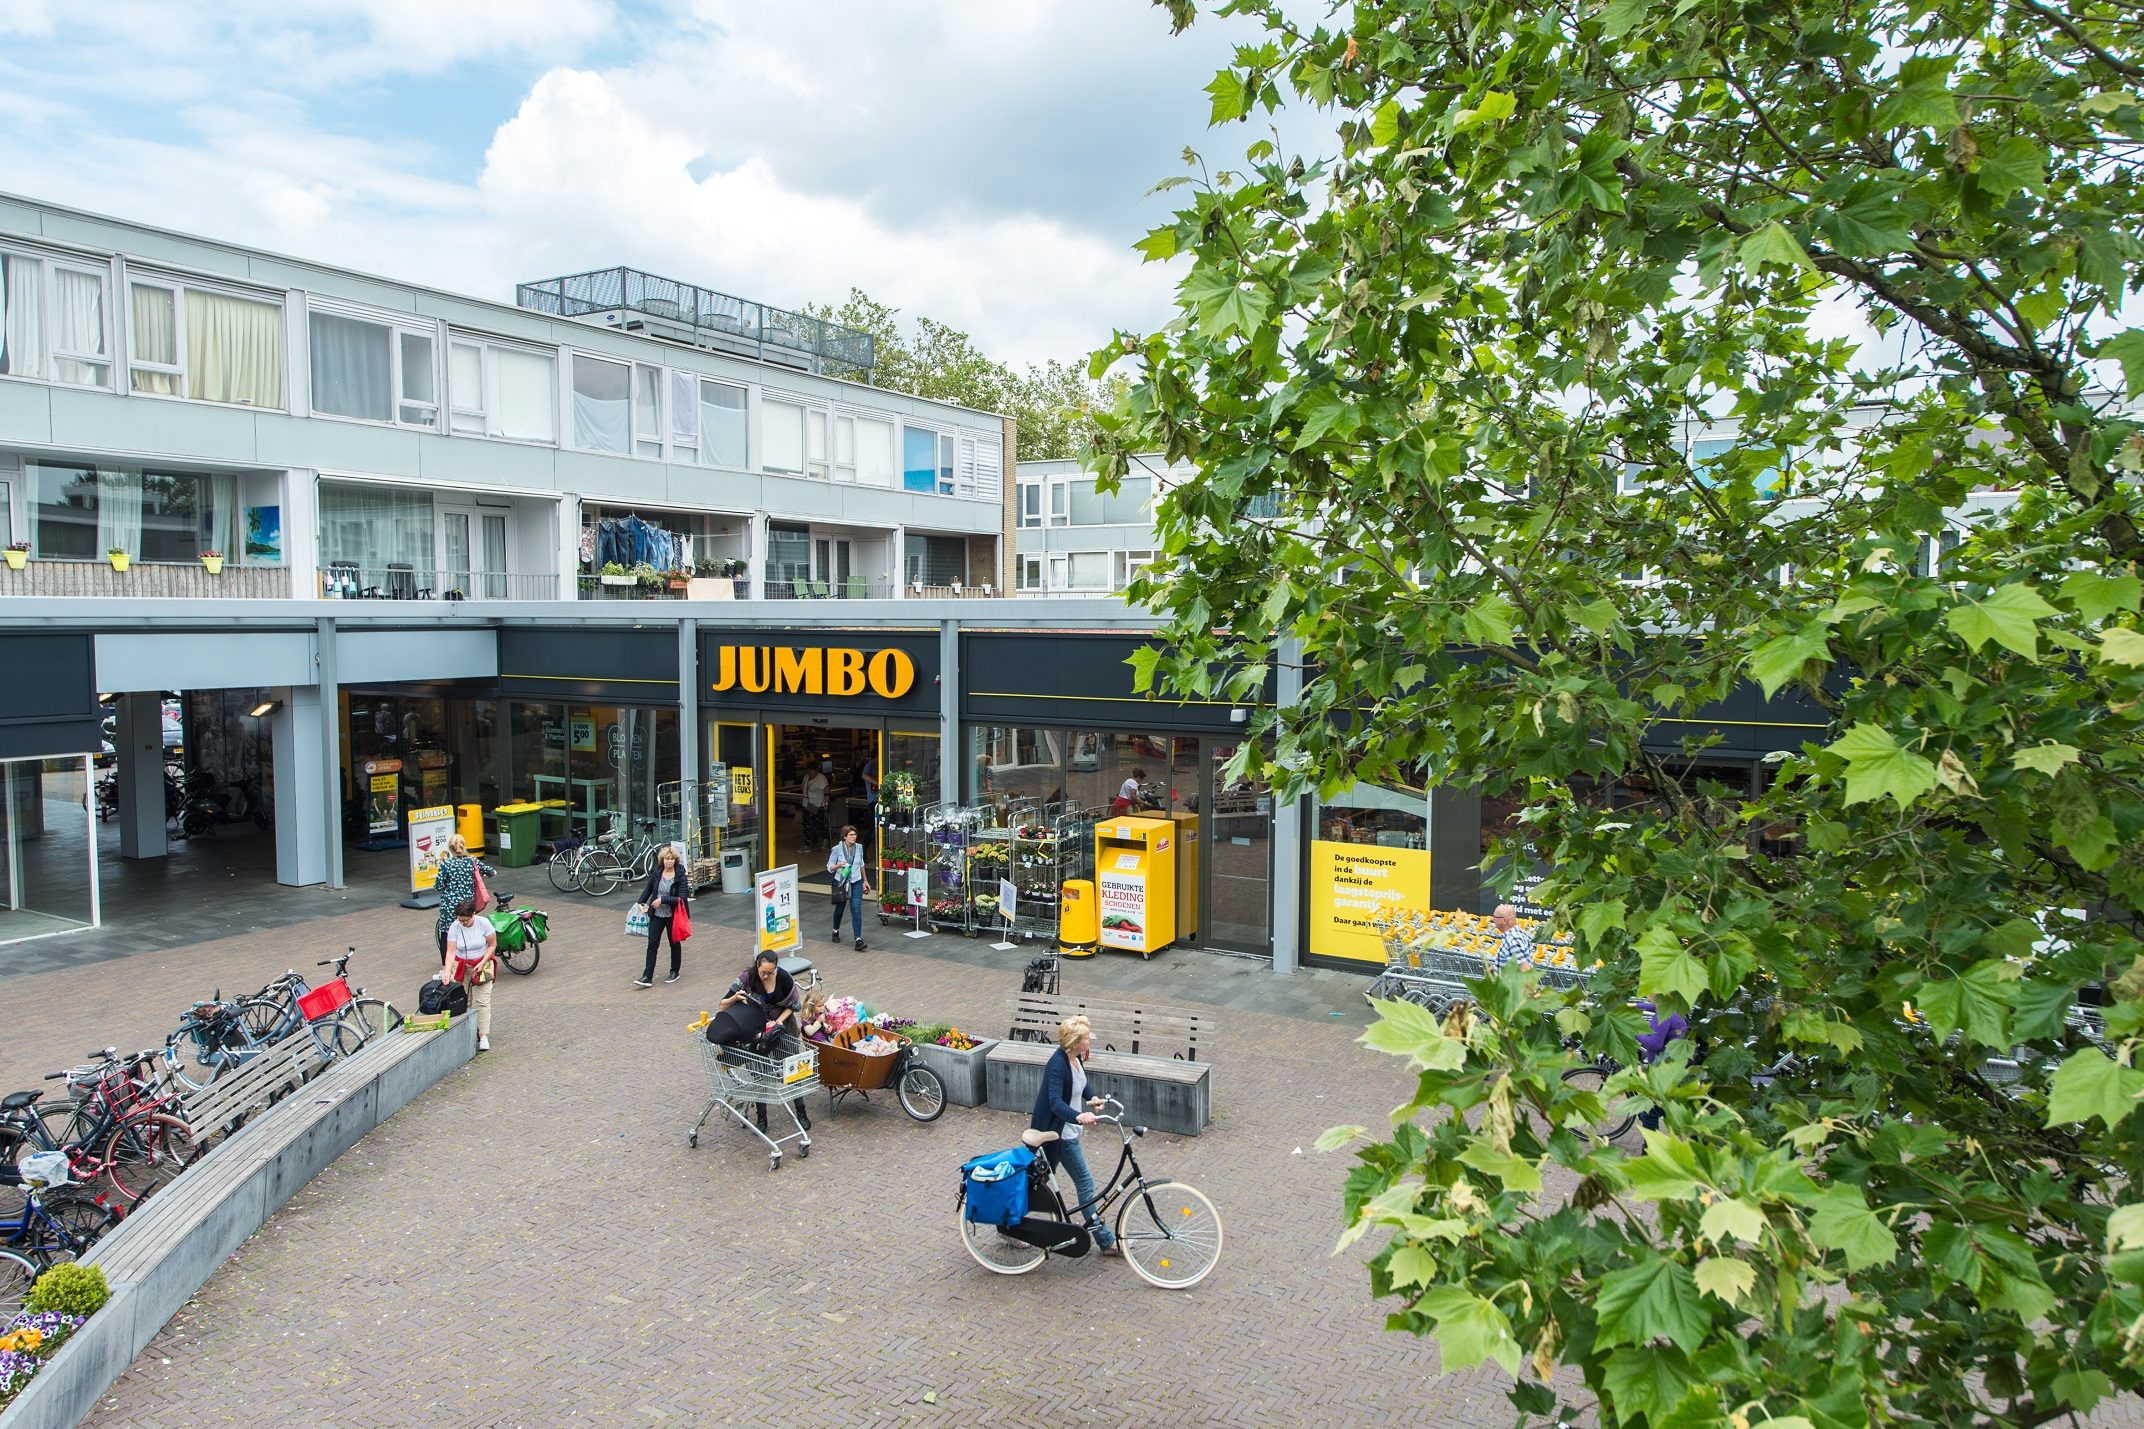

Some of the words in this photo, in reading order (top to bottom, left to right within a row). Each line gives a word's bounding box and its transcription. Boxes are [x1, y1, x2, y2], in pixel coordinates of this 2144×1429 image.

[712, 645, 915, 699] JUMBO
[734, 773, 751, 785] IETS
[734, 785, 752, 794] LEUKS
[415, 808, 448, 820] JUMBO
[1346, 856, 1396, 866] goedkoopste
[1354, 864, 1388, 877] buurt
[1334, 876, 1362, 885] dankzij
[1101, 881, 1144, 893] GEBRUIKTE
[1101, 889, 1144, 903] KLEDING
[1104, 899, 1141, 910] SCHOENEN
[1524, 907, 1543, 916] met
[1334, 917, 1351, 925] Daar
